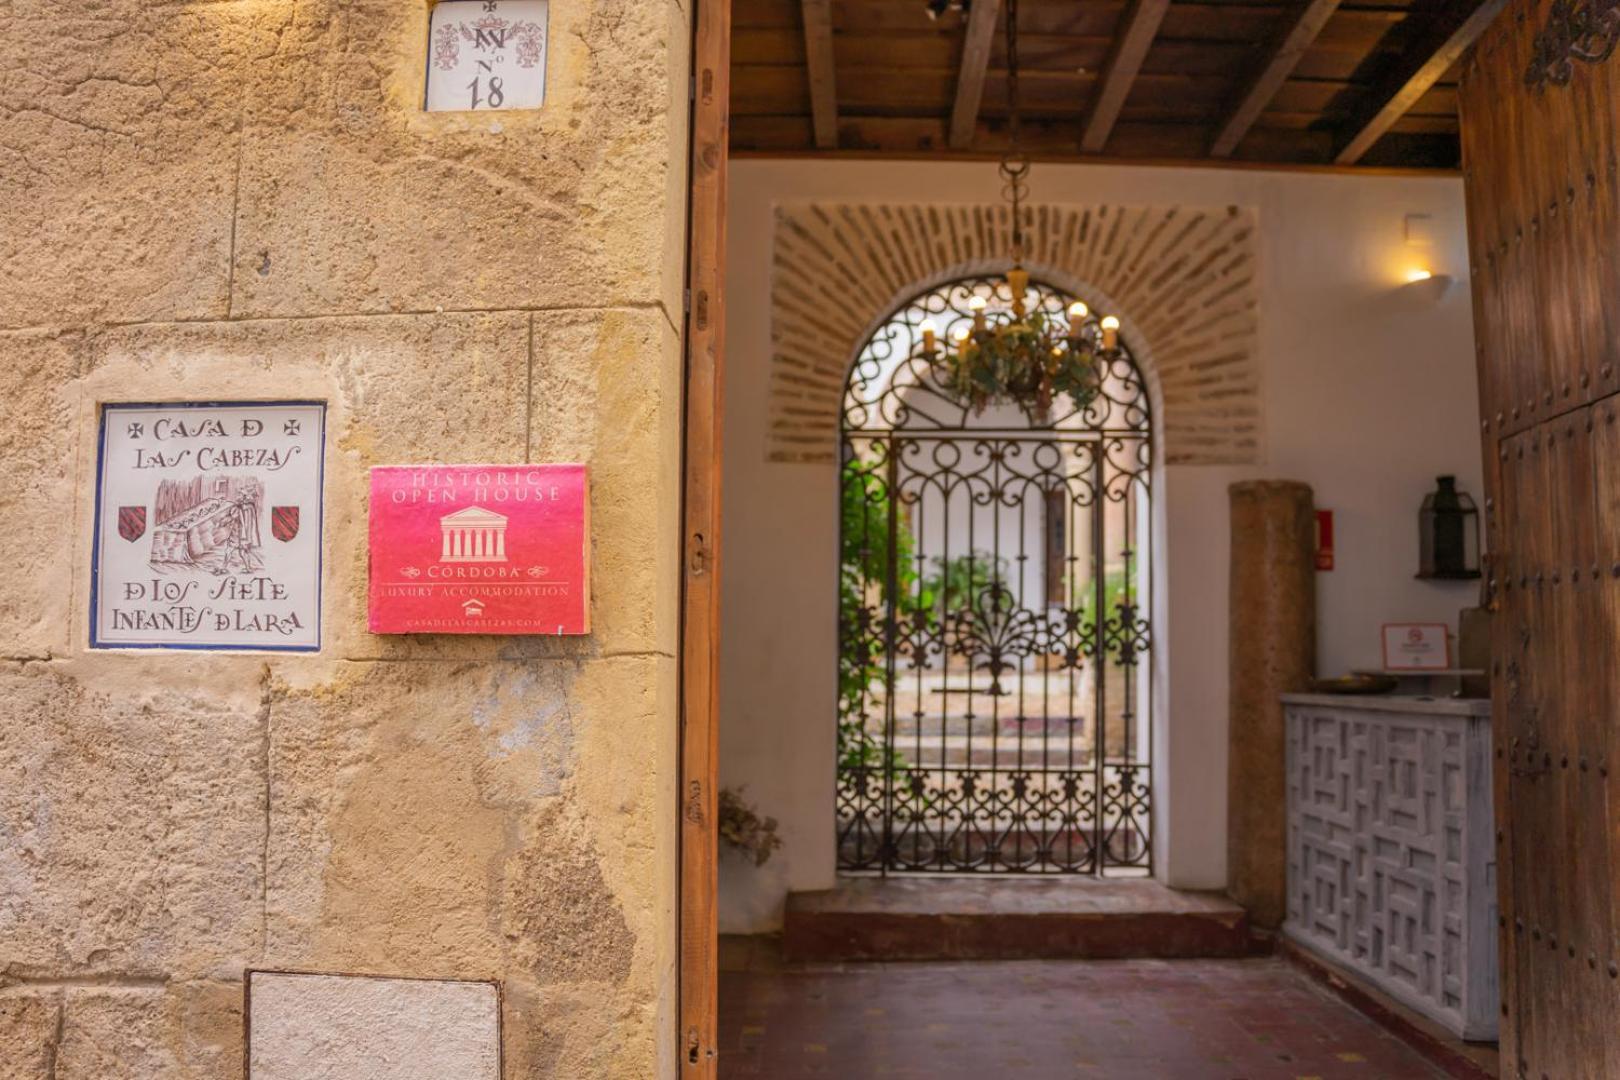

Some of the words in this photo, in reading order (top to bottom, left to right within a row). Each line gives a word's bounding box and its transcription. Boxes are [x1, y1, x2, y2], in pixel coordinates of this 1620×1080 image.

[466, 76, 504, 110] 18
[153, 418, 229, 440] CASA
[132, 447, 191, 469] LAS
[197, 446, 301, 471] CABEZAS
[412, 472, 540, 487] HISTORIC
[392, 489, 456, 504] OPEN
[474, 486, 561, 502] HOUSE
[208, 576, 289, 601] SIETE
[112, 606, 213, 634] INFANTES
